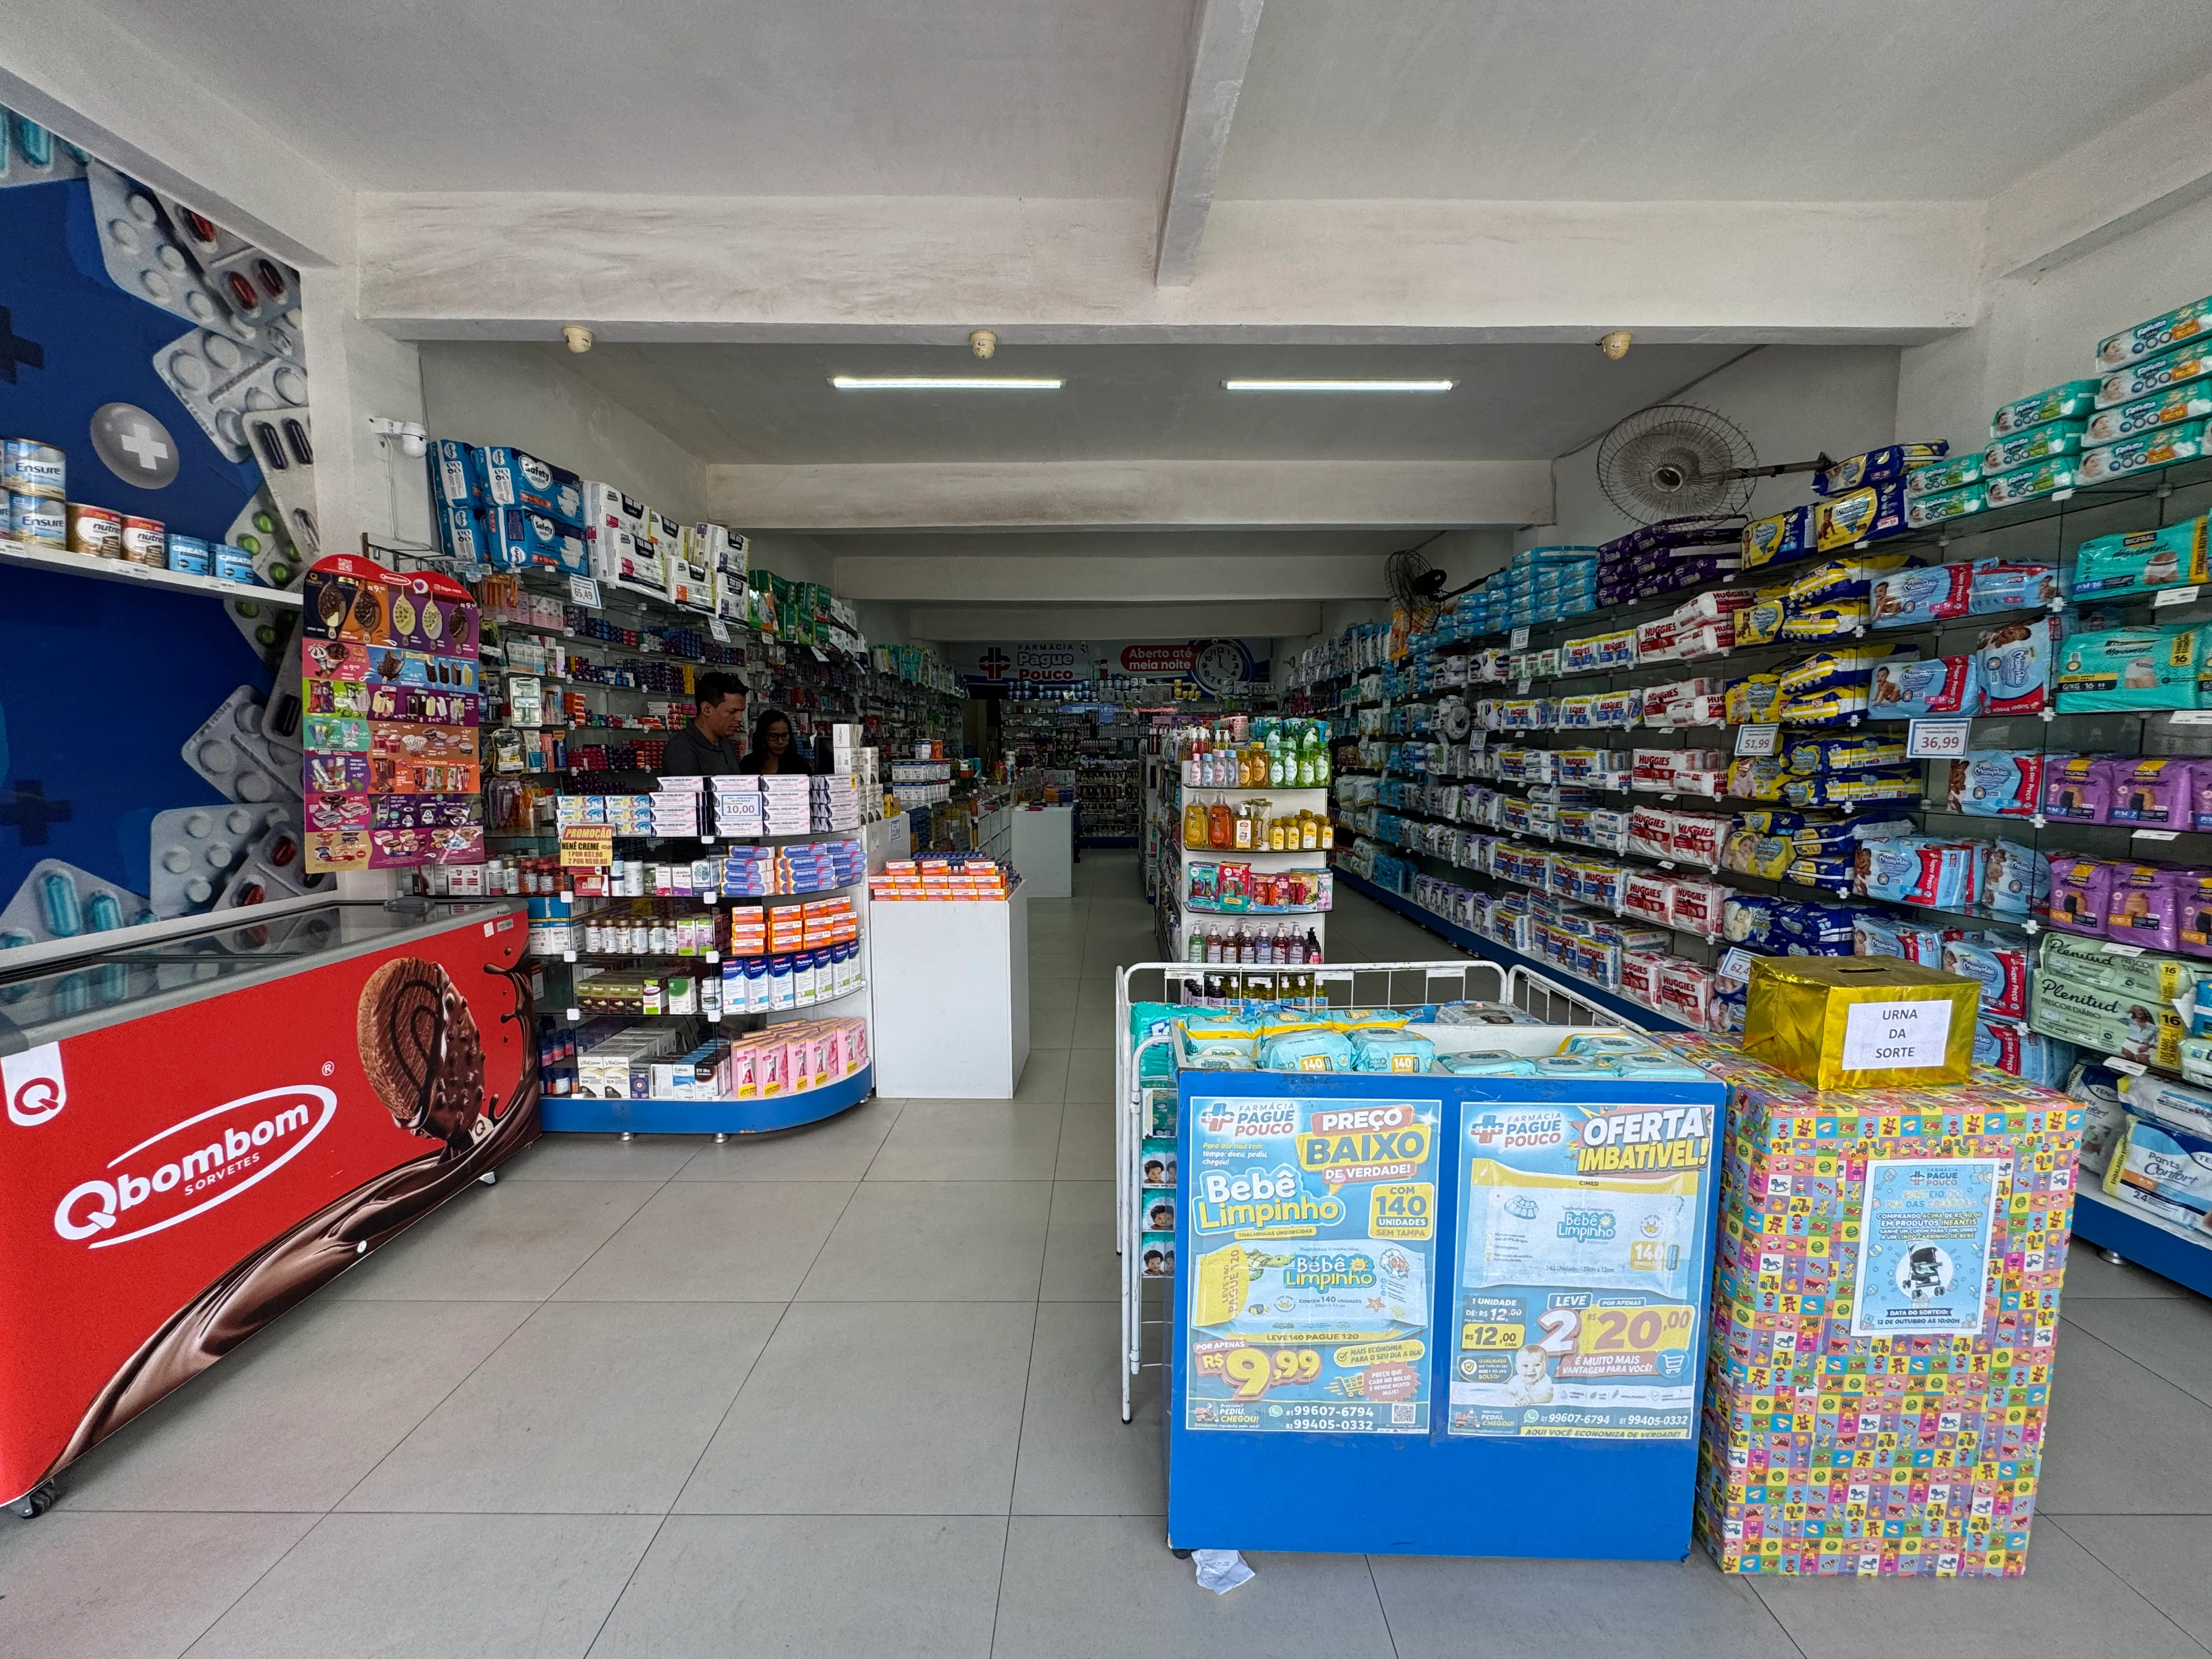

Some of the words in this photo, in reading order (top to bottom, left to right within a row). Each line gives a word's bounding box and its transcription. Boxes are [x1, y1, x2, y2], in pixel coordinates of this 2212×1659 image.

[15, 462, 60, 475] Ensure
[524, 463, 551, 482] Safety
[22, 516, 64, 527] Ensure
[535, 521, 554, 534] Safety
[2125, 534, 2157, 545] BIGFRAL
[574, 589, 593, 600] 65,49
[1645, 622, 1677, 637] HUGGIES
[1129, 648, 1170, 659] Aberto
[1172, 646, 1192, 658] até
[2174, 654, 2187, 663] 16
[1018, 652, 1074, 668] Pague
[1130, 662, 1159, 670] meia
[1161, 661, 1191, 670] noite
[1019, 669, 1074, 680] Pouco
[1744, 738, 1769, 750] 51,99
[1921, 737, 1959, 751] 36,99
[1639, 755, 1670, 766] HUGGIES
[2029, 764, 2038, 781] Super
[2025, 783, 2035, 801] Preço
[726, 805, 755, 814] 10,00
[1634, 812, 1666, 828] HUGGIES
[566, 827, 612, 839] PROMOÇÃO
[1678, 823, 1714, 837] HUGGIES
[562, 841, 577, 850] NENÊ
[1497, 850, 1519, 862] HUGGIES
[1555, 865, 1579, 879] HUGGIES
[1585, 872, 1614, 883] HUGGIES
[1630, 883, 1662, 898] HUGGIES
[1677, 888, 1707, 902] HUGGIES
[1550, 934, 1575, 946] HUGGIES
[1579, 946, 1605, 960] HUGGIES
[2049, 938, 2114, 967] Plenitud
[2120, 957, 2155, 969] FRESCOR
[2010, 965, 2019, 983] Super
[1663, 976, 1695, 992] HUGGIES
[2042, 979, 2118, 1013] Plenitud
[2041, 997, 2072, 1012] FRESCOR
[1882, 1009, 1918, 1020] URNA
[2162, 1014, 2181, 1026] 16
[1889, 1029, 1906, 1039] DA
[1876, 1047, 1915, 1058] SORTE
[1303, 1059, 1323, 1069] 140
[1394, 1058, 1411, 1069] 140
[1239, 1103, 1294, 1111] FARMÁCIA
[1238, 1110, 1295, 1124] PAGUE
[1323, 1109, 1402, 1131] PREÇO
[1235, 1122, 1294, 1137] POUCO
[1506, 1120, 1561, 1135] PAGUE
[1584, 1107, 1705, 1146] OFERTA
[1505, 1132, 1561, 1148] POUCO
[1306, 1131, 1425, 1165] BAIXO
[1578, 1138, 1709, 1172] IMBATÍVEL!
[2148, 1152, 2180, 1169] Pants
[54, 1103, 309, 1241] Qbombom
[184, 1152, 261, 1198] SORVETES
[1325, 1169, 1343, 1180] DE
[1346, 1164, 1411, 1178] VERDADE!
[1206, 1170, 1296, 1203] Bebê
[1390, 1187, 1415, 1195] COM
[2133, 1190, 2147, 1203] 24
[1199, 1196, 1339, 1228] Limpinho
[1376, 1196, 1427, 1216] 140
[1566, 1214, 1597, 1227] Bebê
[1559, 1222, 1613, 1241] Limpinho
[1297, 1257, 1345, 1273] Bebê
[1286, 1271, 1373, 1291] Limpinho
[1228, 1272, 1239, 1313] PAGUE
[1556, 1295, 1587, 1306] LEVE
[1540, 1310, 1577, 1352] 2
[1351, 1347, 1366, 1356] MAIS
[1368, 1345, 1402, 1353] ECONOMIA
[1583, 1356, 1613, 1366] MUITO
[1615, 1355, 1640, 1364] MAIS
[1562, 1366, 1605, 1374] VANTAGEM
[1629, 1364, 1652, 1373] VOCÊ!
[1548, 1413, 1610, 1425] 99607-6794
[1628, 1415, 1688, 1426] 99405-0332
